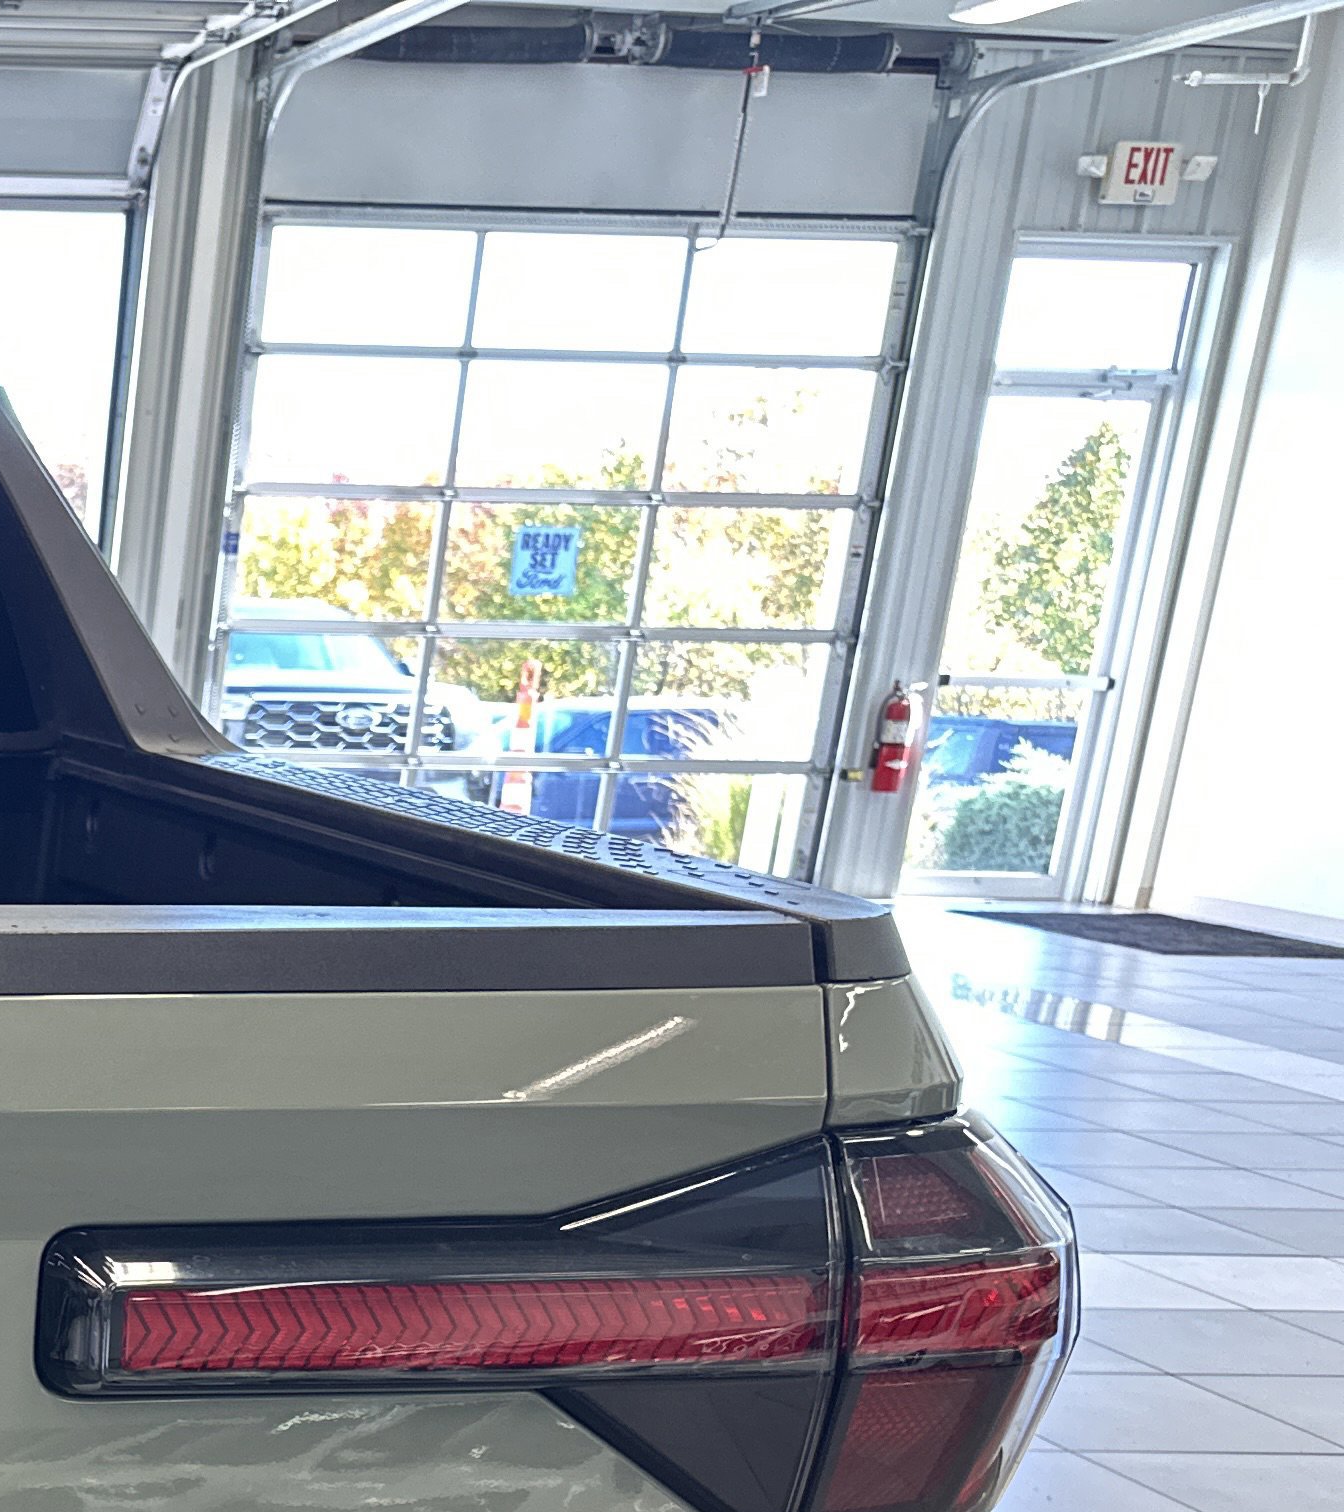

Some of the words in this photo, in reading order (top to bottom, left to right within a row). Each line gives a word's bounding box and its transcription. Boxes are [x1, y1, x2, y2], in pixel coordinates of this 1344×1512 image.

[1123, 146, 1175, 186] EXIT
[521, 532, 574, 551] READY
[529, 552, 558, 569] SET
[516, 568, 567, 590] Ford
